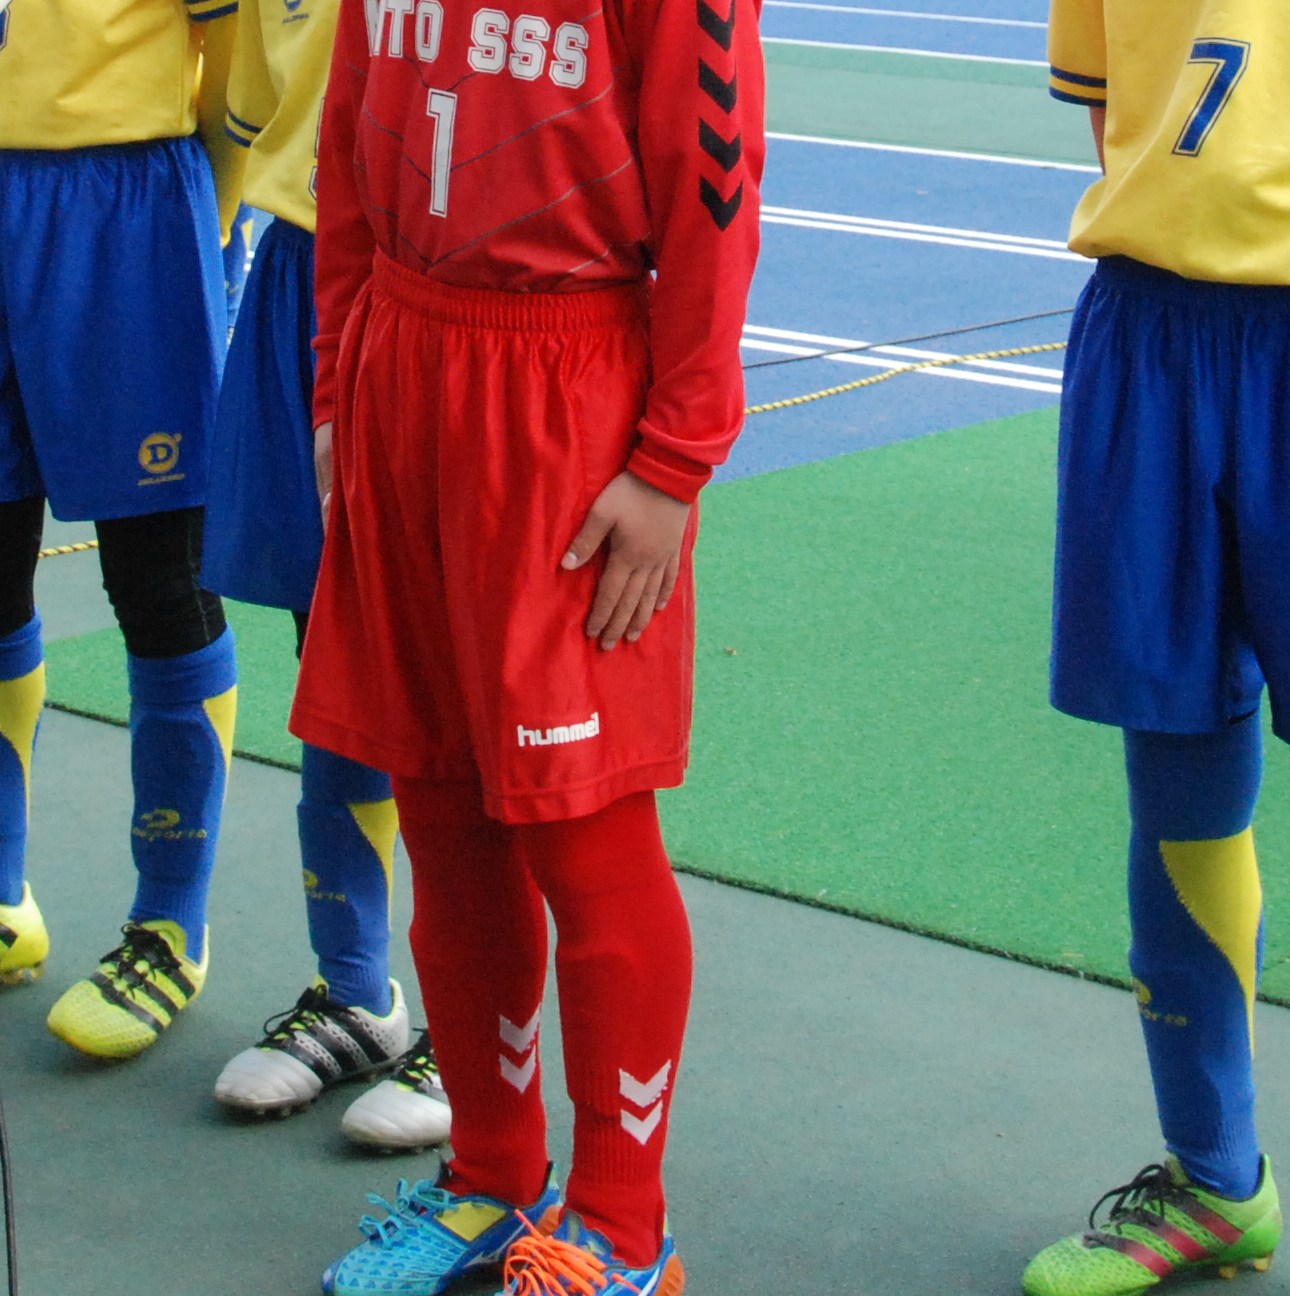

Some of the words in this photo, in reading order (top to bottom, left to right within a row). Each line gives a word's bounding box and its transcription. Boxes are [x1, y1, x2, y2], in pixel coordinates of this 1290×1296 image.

[467, 8, 589, 89] SSS
[1170, 37, 1252, 158] 7
[426, 88, 458, 218] 1
[516, 711, 601, 748] hummel
